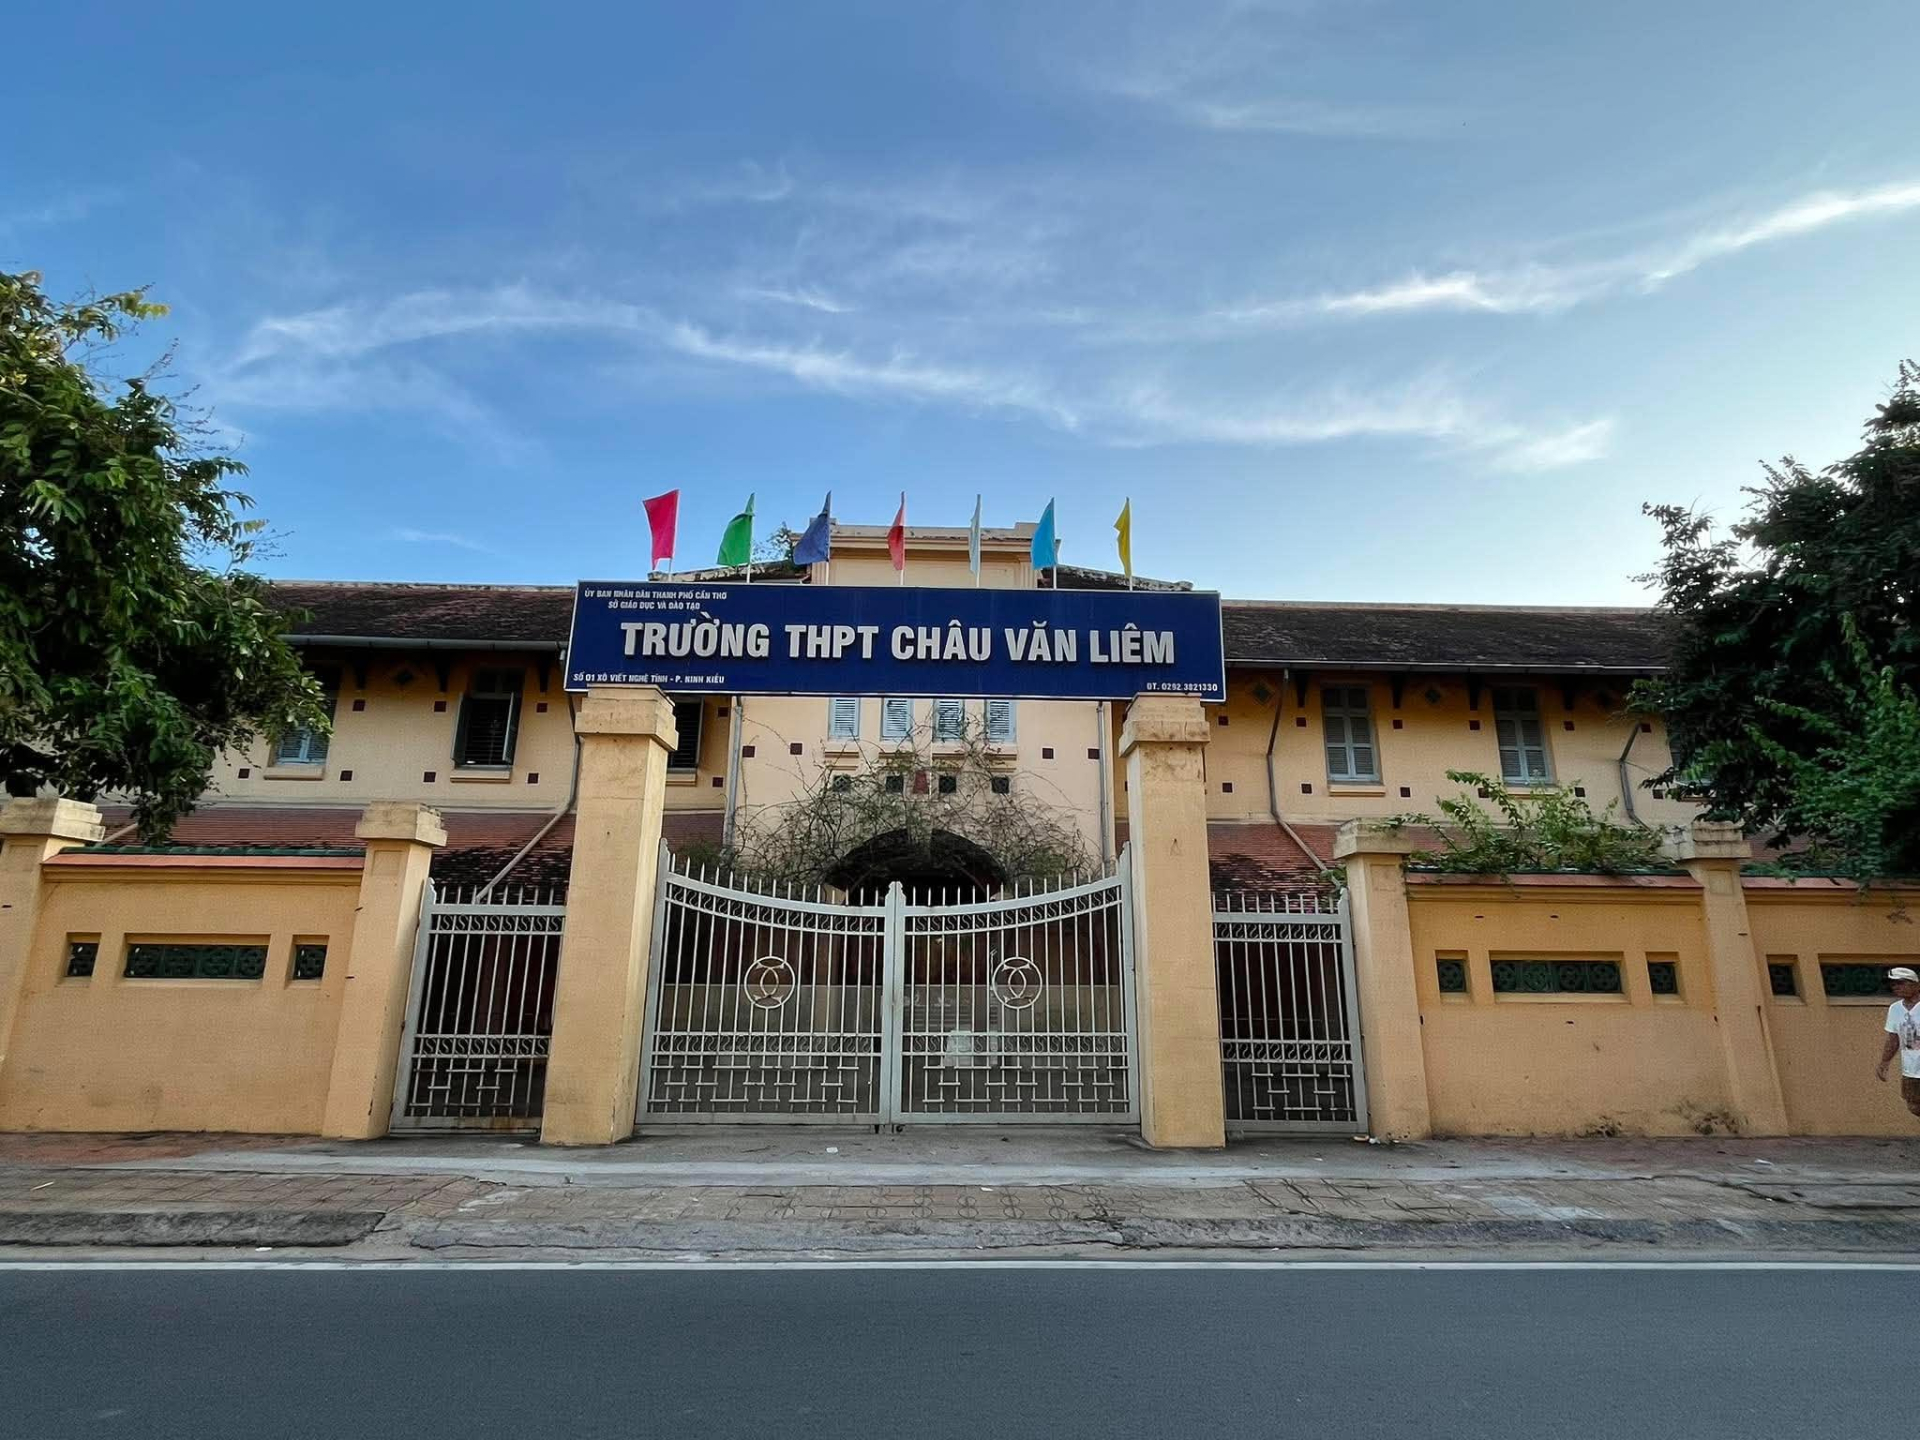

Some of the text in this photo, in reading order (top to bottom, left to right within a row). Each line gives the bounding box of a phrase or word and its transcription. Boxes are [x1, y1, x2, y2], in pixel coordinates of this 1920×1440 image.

[596, 590, 612, 598] BAN
[613, 589, 634, 599] NHÂN
[635, 589, 651, 599] DÂN
[677, 589, 695, 600] PHỐ
[620, 600, 638, 609] GIÁO
[639, 601, 655, 611] DỤC
[657, 601, 667, 610] VÀ
[685, 602, 701, 612] TẠO
[620, 612, 1174, 664] TRƯỜNG THPT CHÂU VĂN LIÊM
[573, 672, 585, 682] SỐ
[585, 674, 595, 682] 01
[597, 673, 608, 682] XÔ
[675, 675, 683, 683] P.
